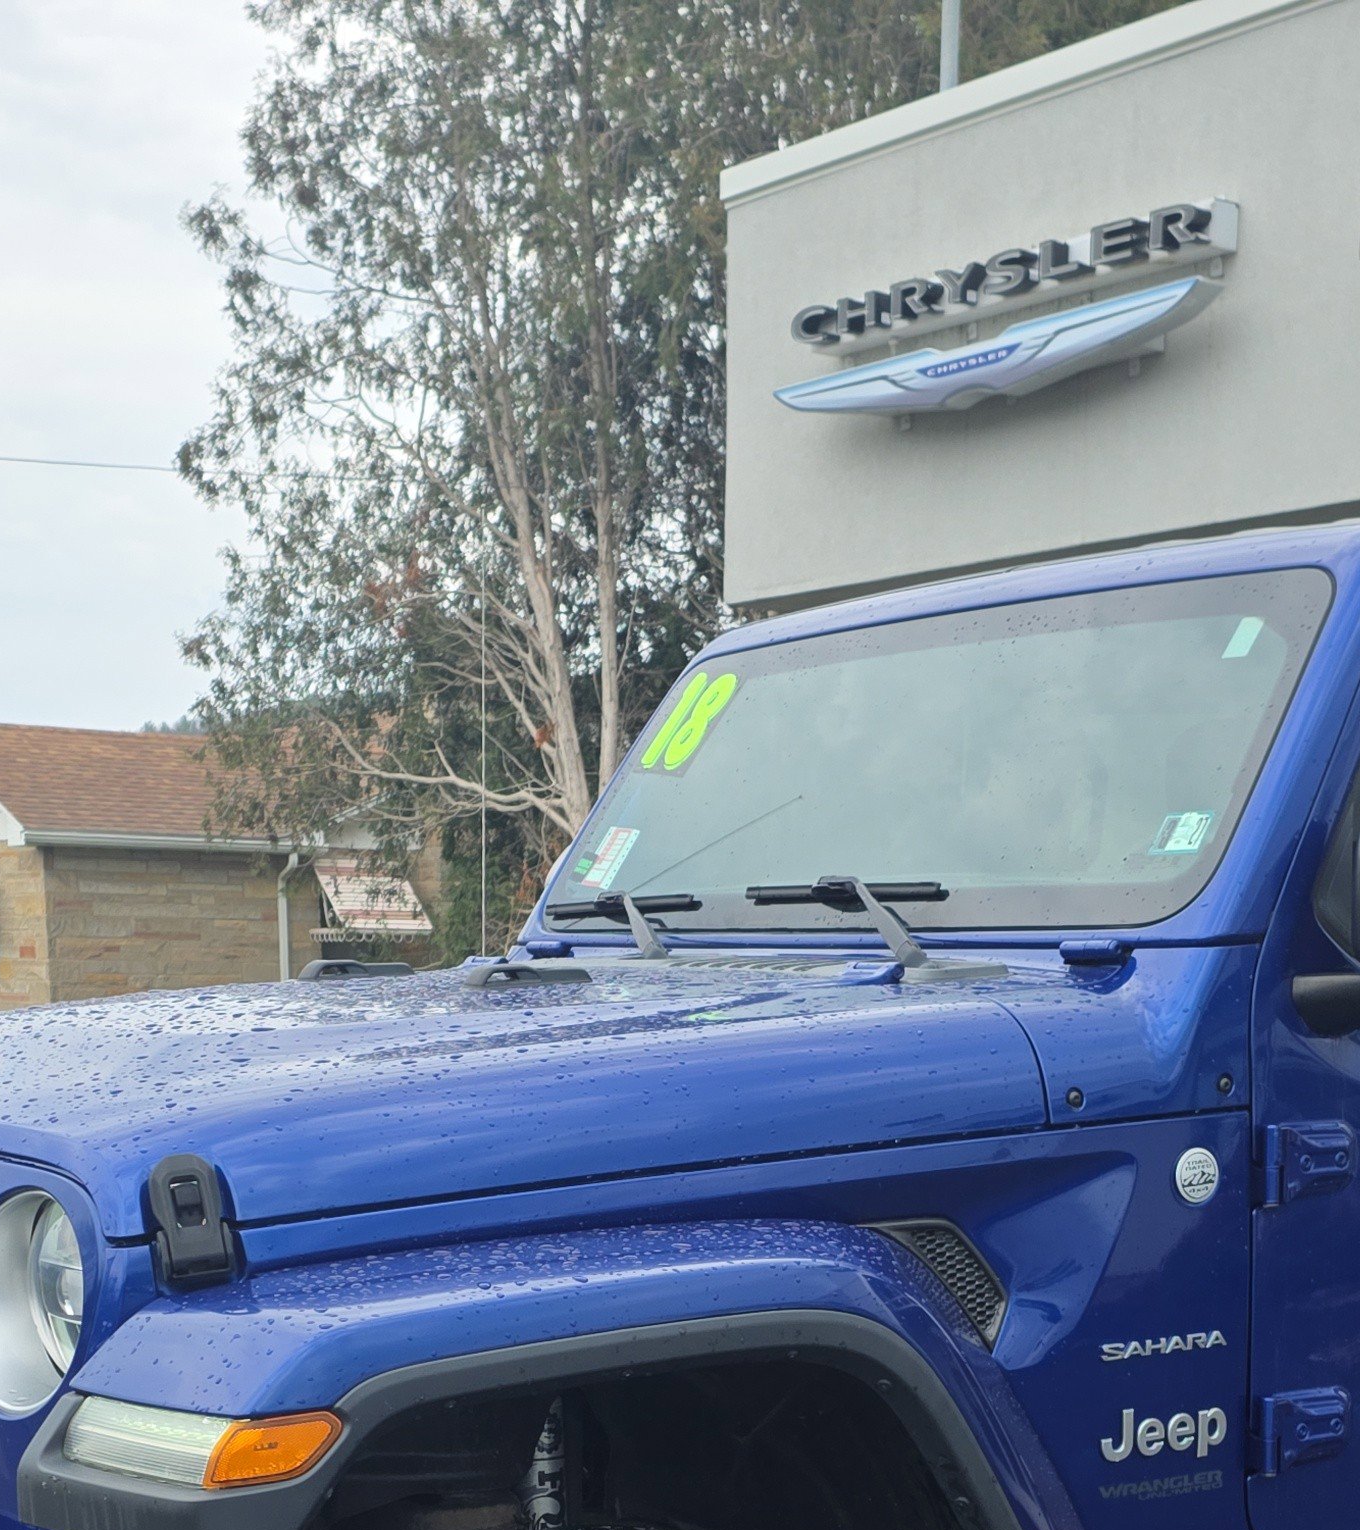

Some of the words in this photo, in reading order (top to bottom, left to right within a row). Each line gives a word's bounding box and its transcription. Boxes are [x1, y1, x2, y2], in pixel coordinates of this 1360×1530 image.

[790, 202, 1212, 344] CHRYSLER
[926, 347, 1010, 378] CHRYSLER
[641, 672, 738, 771] 18
[1100, 1330, 1228, 1362] SAHARA
[1100, 1407, 1228, 1463] Jeep
[1098, 1470, 1223, 1499] WRANGLER
